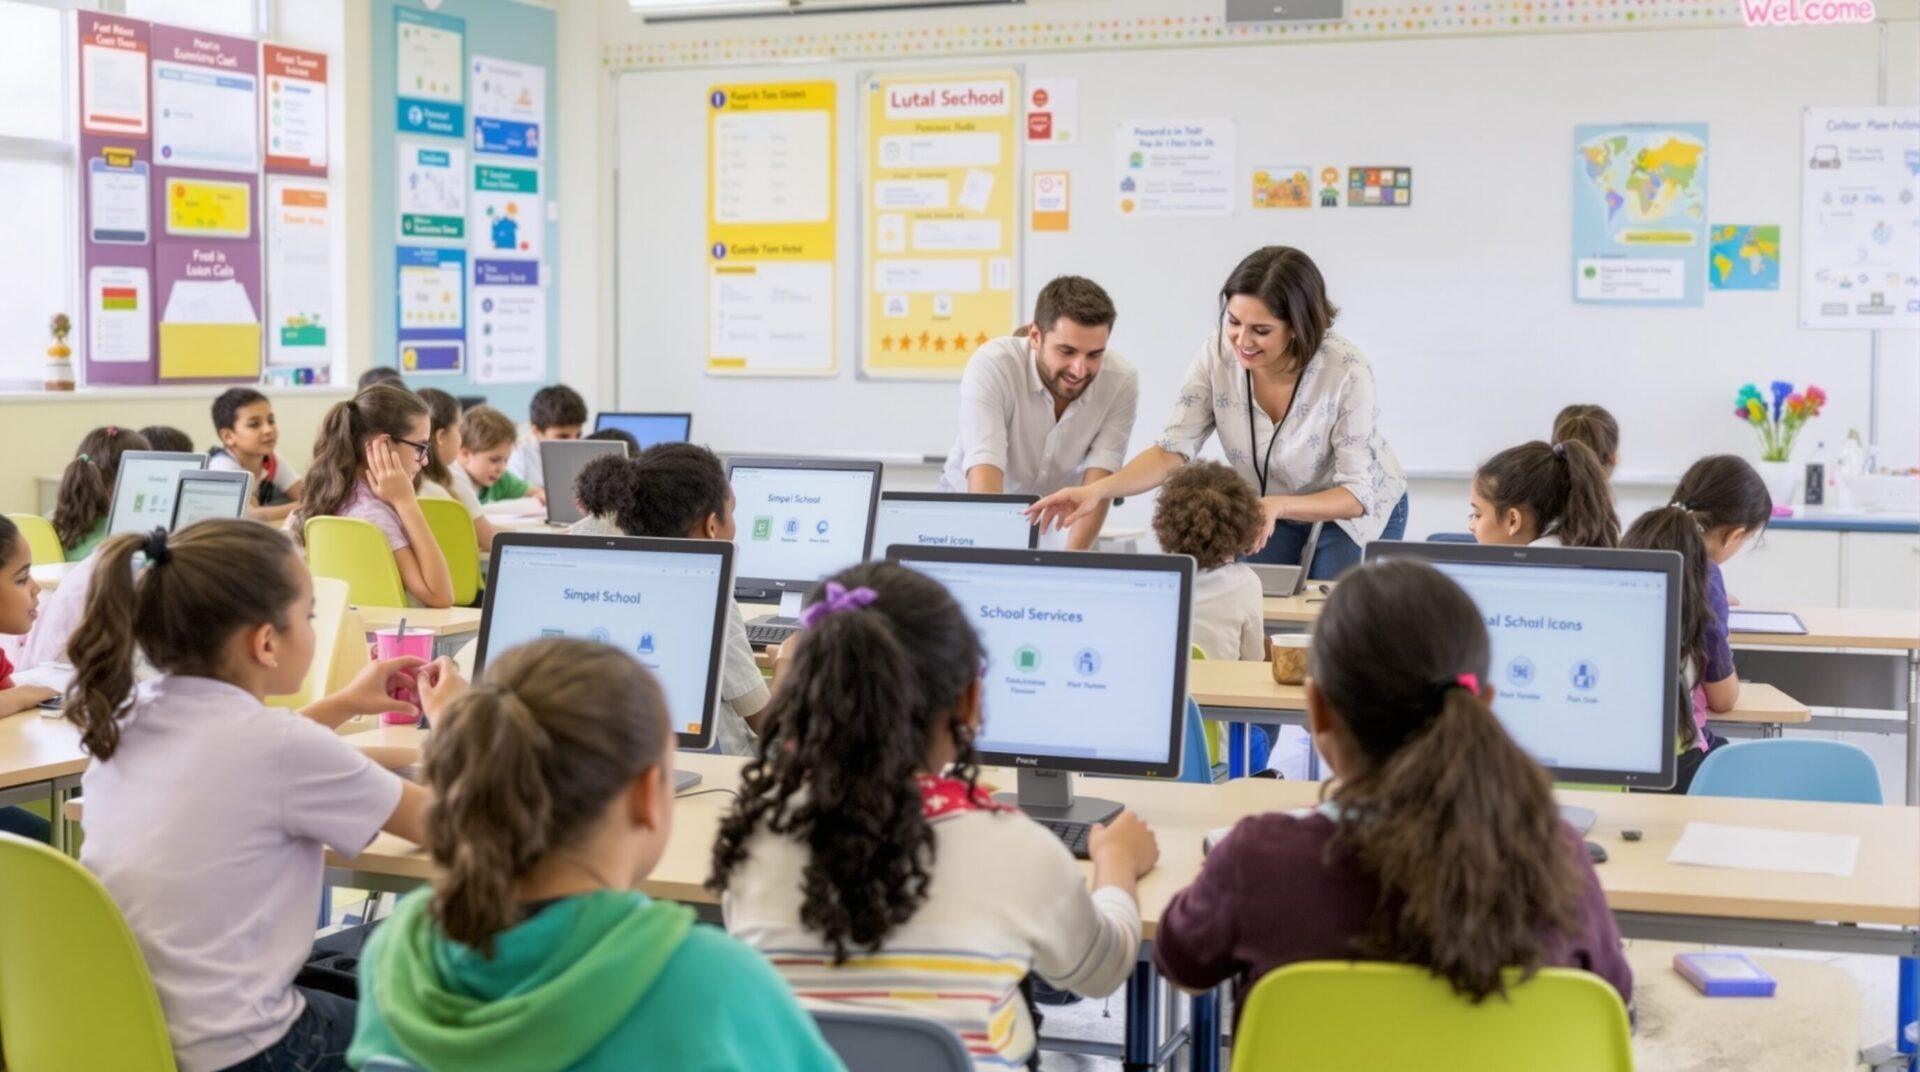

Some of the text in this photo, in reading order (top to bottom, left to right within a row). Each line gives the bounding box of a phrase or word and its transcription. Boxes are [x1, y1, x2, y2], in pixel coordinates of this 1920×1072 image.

[1744, 0, 1872, 22] Welcome
[891, 88, 1004, 109] Lutal Sechool
[794, 495, 821, 504] School
[563, 588, 641, 604] Simpel School
[980, 605, 1083, 623] School Services
[1547, 617, 1582, 631] Icons
